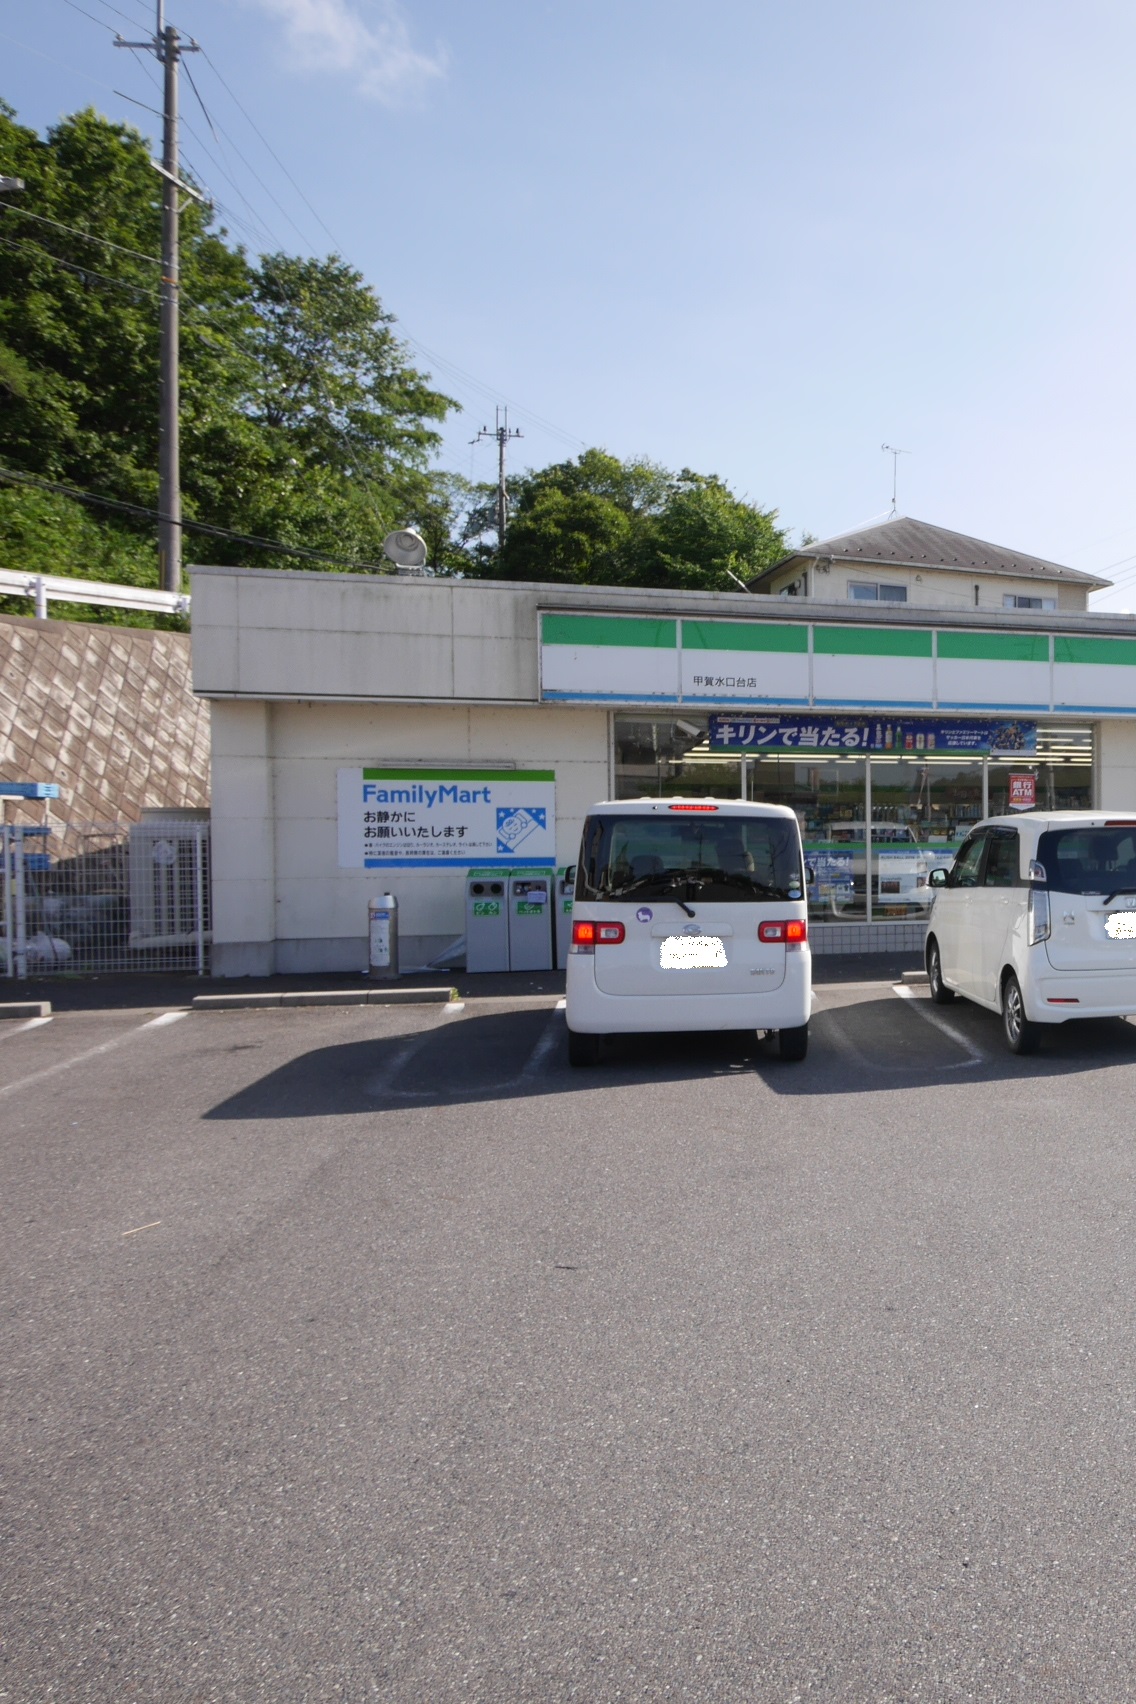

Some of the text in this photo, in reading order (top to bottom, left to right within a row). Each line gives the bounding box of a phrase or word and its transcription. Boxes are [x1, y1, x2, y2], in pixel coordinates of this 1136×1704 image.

[693, 675, 757, 688] 甲賀水口台店
[715, 724, 870, 747] キリンで当たる!
[363, 784, 491, 808] FamilyMart
[1012, 788, 1033, 797] ATM
[363, 811, 416, 823] お静かに
[364, 825, 469, 838] お願いいたします
